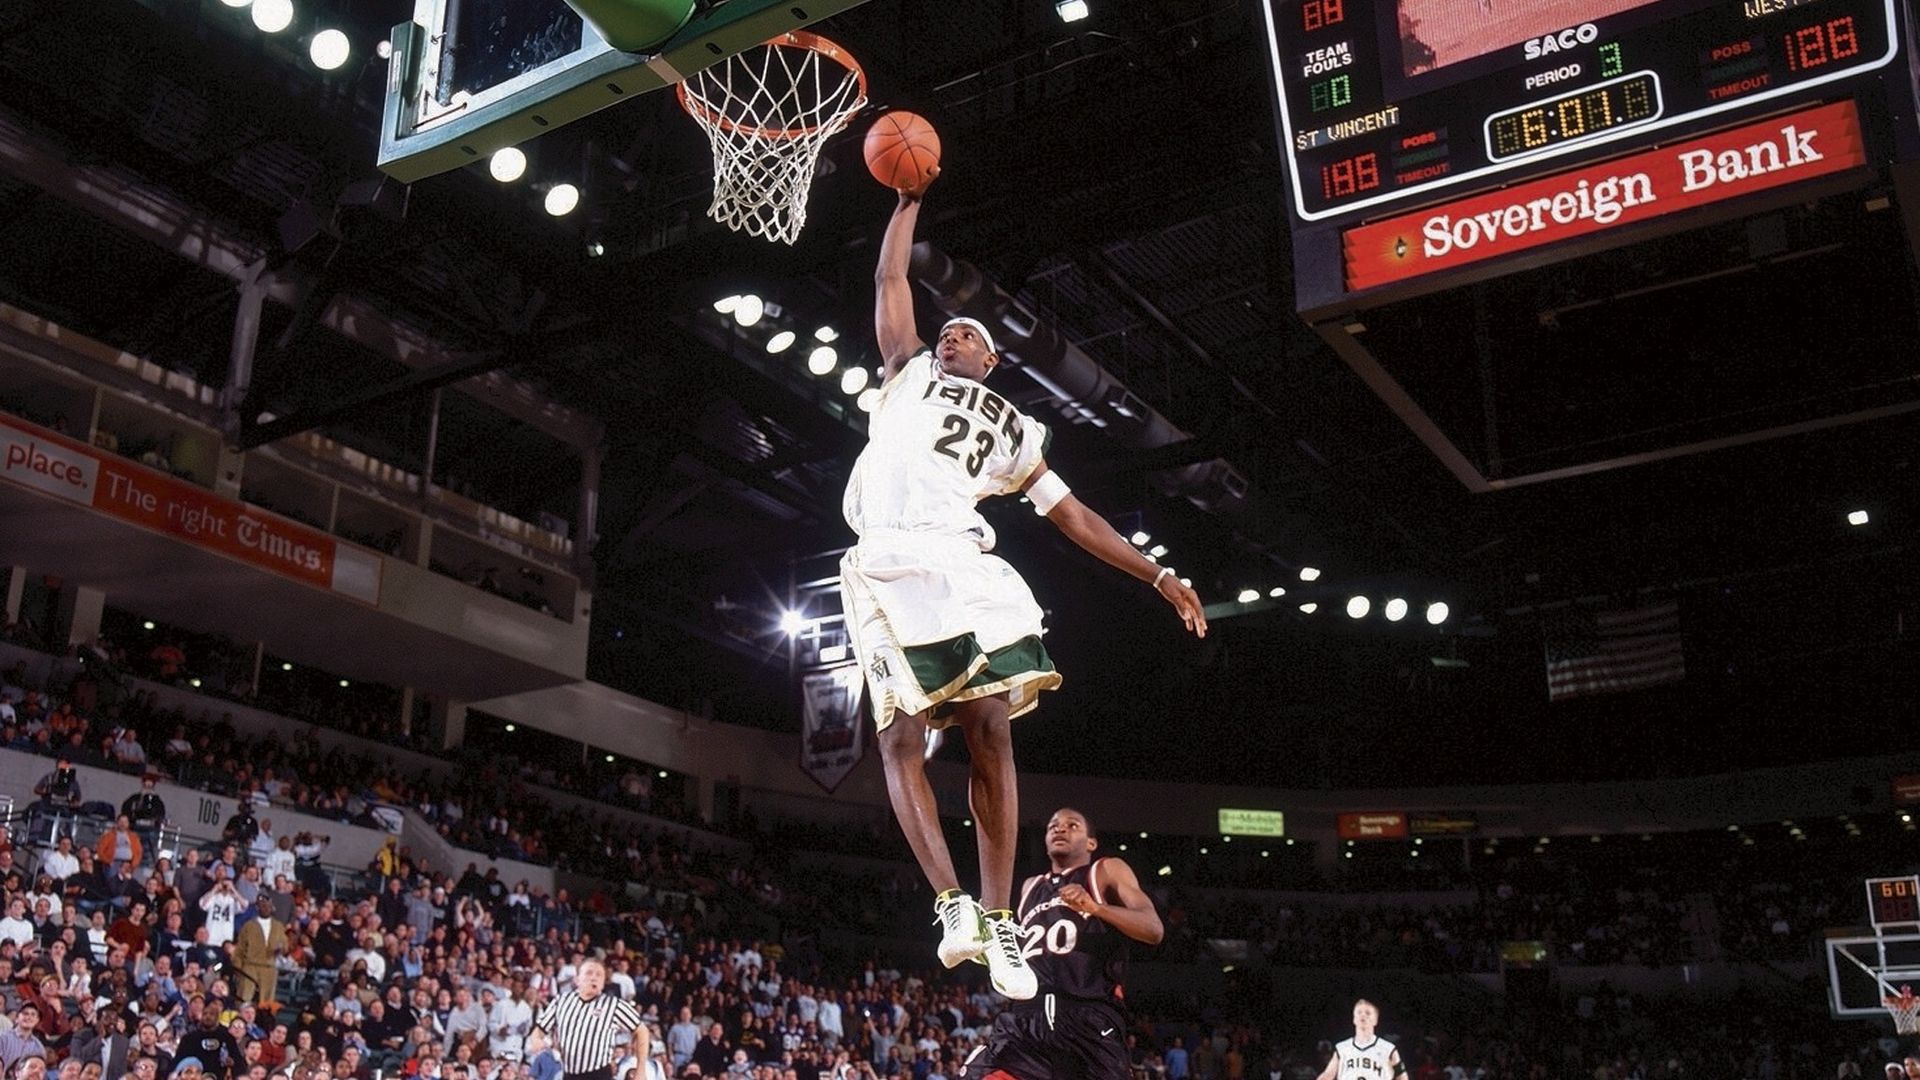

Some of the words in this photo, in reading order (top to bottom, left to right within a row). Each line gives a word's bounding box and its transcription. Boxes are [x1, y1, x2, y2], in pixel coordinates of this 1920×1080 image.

[1305, 42, 1348, 63] TEAM
[1524, 23, 1599, 60] SACO
[1712, 41, 1751, 60] POSS
[1303, 53, 1352, 78] FOULS
[1599, 42, 1623, 78] 3
[1525, 64, 1581, 90] PERIOD
[1710, 74, 1769, 99] TIMEOUT
[1296, 130, 1319, 150] ST
[1327, 109, 1399, 141] VINCENT
[1402, 132, 1437, 149] POSS
[1396, 162, 1449, 184] TIMEOUT
[1422, 170, 1655, 258] Sovereign
[1679, 125, 1823, 193] Bank
[922, 380, 1024, 457] IRISH
[933, 414, 995, 478] 23
[6, 443, 88, 488] place.
[106, 470, 157, 512] The
[167, 500, 227, 537] right
[237, 515, 326, 573] Times.
[198, 798, 221, 826] 106
[211, 904, 230, 922] 24
[1022, 919, 1077, 960] 20
